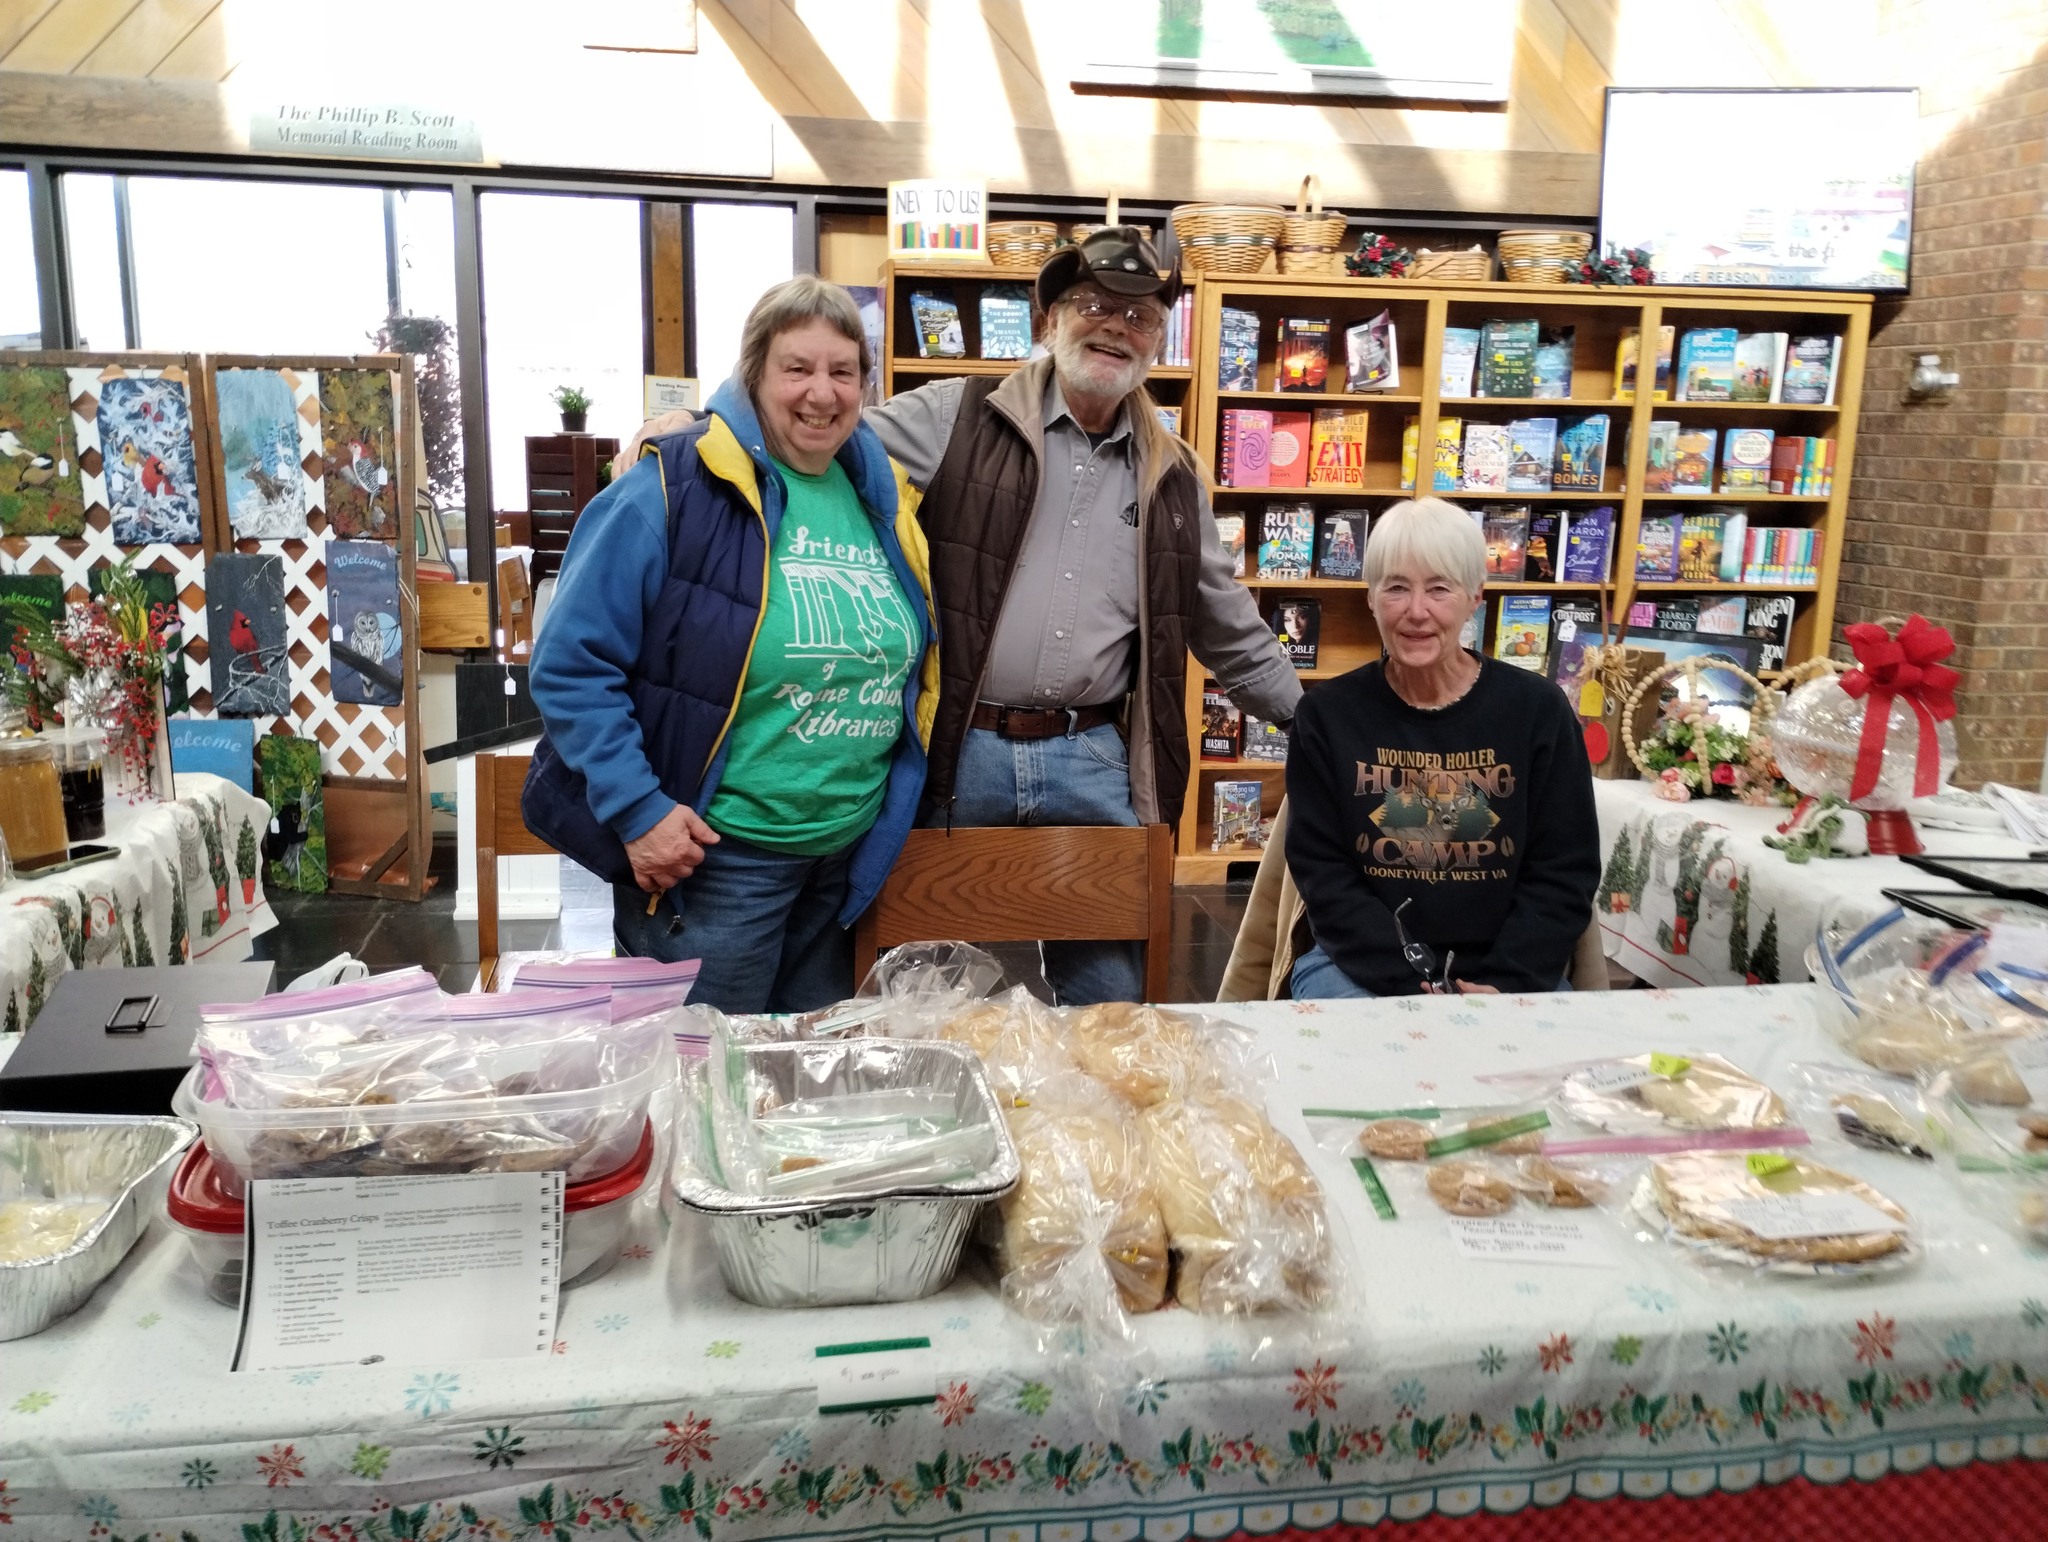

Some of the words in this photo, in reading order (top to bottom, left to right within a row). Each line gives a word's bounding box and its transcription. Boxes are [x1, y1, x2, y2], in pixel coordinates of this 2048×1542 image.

[277, 104, 311, 120] The
[318, 105, 379, 128] Phillip
[385, 109, 403, 125] B.
[410, 110, 455, 128] Scott
[277, 127, 347, 146] Memorial
[352, 129, 411, 150] Reading
[416, 132, 458, 150] Room
[895, 189, 923, 214] NE
[934, 189, 955, 213] TO
[1679, 271, 1700, 283] HE
[1708, 271, 1760, 284] REASON
[1565, 431, 1603, 443] EICHS
[1317, 441, 1363, 468] EXIT
[1562, 461, 1592, 473] EVIL
[1311, 467, 1365, 484] STRATEGY
[1553, 473, 1599, 485] BONES
[1265, 511, 1313, 527] RUTH
[1577, 518, 1598, 526] JAN
[1263, 527, 1313, 542] WARE
[1568, 527, 1605, 537] KARON
[787, 526, 890, 567] Friends
[334, 553, 387, 570] Welcome
[1267, 552, 1309, 560] WOMAN
[1258, 567, 1299, 580] SUITE
[1324, 567, 1357, 577] SOCIETY
[0, 591, 52, 608] elcome
[1557, 609, 1597, 623] OUTPOST
[1656, 611, 1697, 622] CHARLES
[1747, 608, 1778, 628] KING
[1660, 620, 1692, 631] TODD
[822, 660, 837, 681] of
[787, 708, 900, 743] Libraries
[173, 730, 243, 753] elcome
[1205, 738, 1230, 750] WASHITA
[1376, 747, 1442, 769] WOUNDED
[1446, 748, 1496, 769] HOLLER
[1354, 760, 1516, 799] HUNTING
[1372, 837, 1497, 871] CAMP
[1363, 865, 1448, 881] LOONEYVILLE
[1451, 870, 1487, 881] WEST
[1491, 869, 1508, 879] VA
[266, 1219, 299, 1229] Toffee
[300, 1216, 348, 1226] Cranberry
[350, 1213, 380, 1223] Crisps
